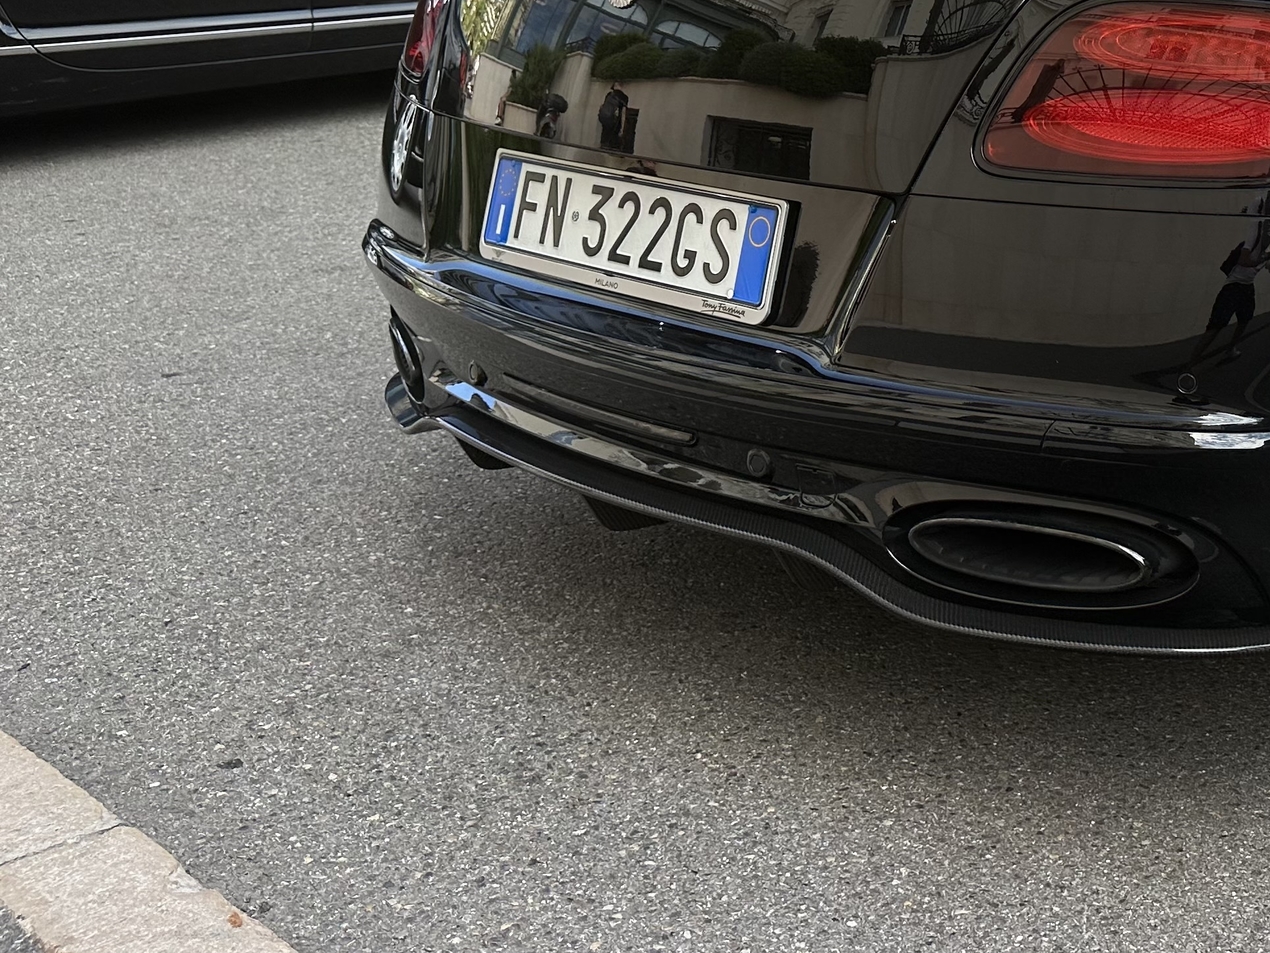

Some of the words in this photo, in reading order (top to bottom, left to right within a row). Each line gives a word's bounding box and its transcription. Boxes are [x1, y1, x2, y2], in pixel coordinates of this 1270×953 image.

[513, 170, 573, 248] FN
[581, 184, 738, 285] 322GS
[594, 277, 619, 290] MILANO
[701, 299, 718, 315] Tony
